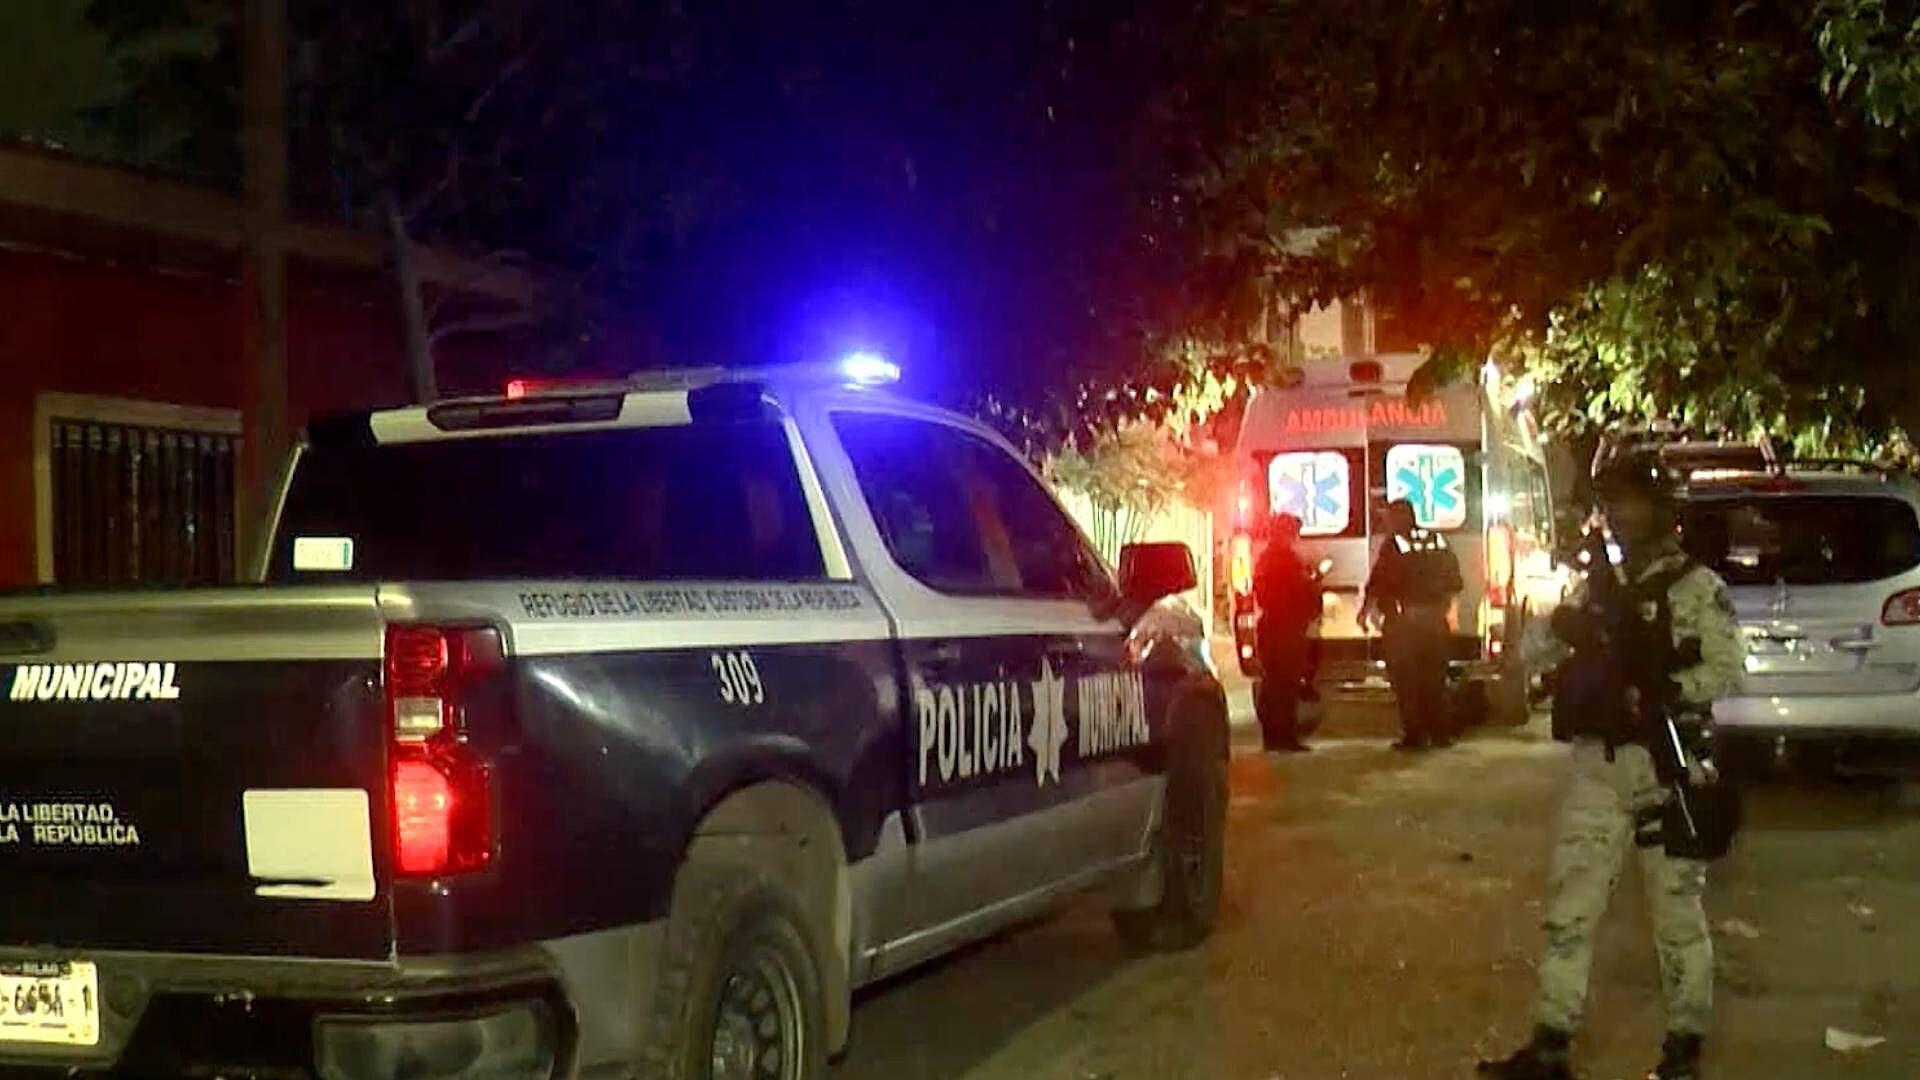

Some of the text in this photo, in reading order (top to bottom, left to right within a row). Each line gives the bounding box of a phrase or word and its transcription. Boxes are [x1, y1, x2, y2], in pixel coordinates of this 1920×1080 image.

[1284, 400, 1446, 432] AMBULANCIA
[519, 593, 595, 618] REFUGIO
[9, 662, 180, 700] MUNICIPAL
[711, 650, 764, 706] 309
[0, 803, 20, 822] LA
[0, 823, 20, 843] LA
